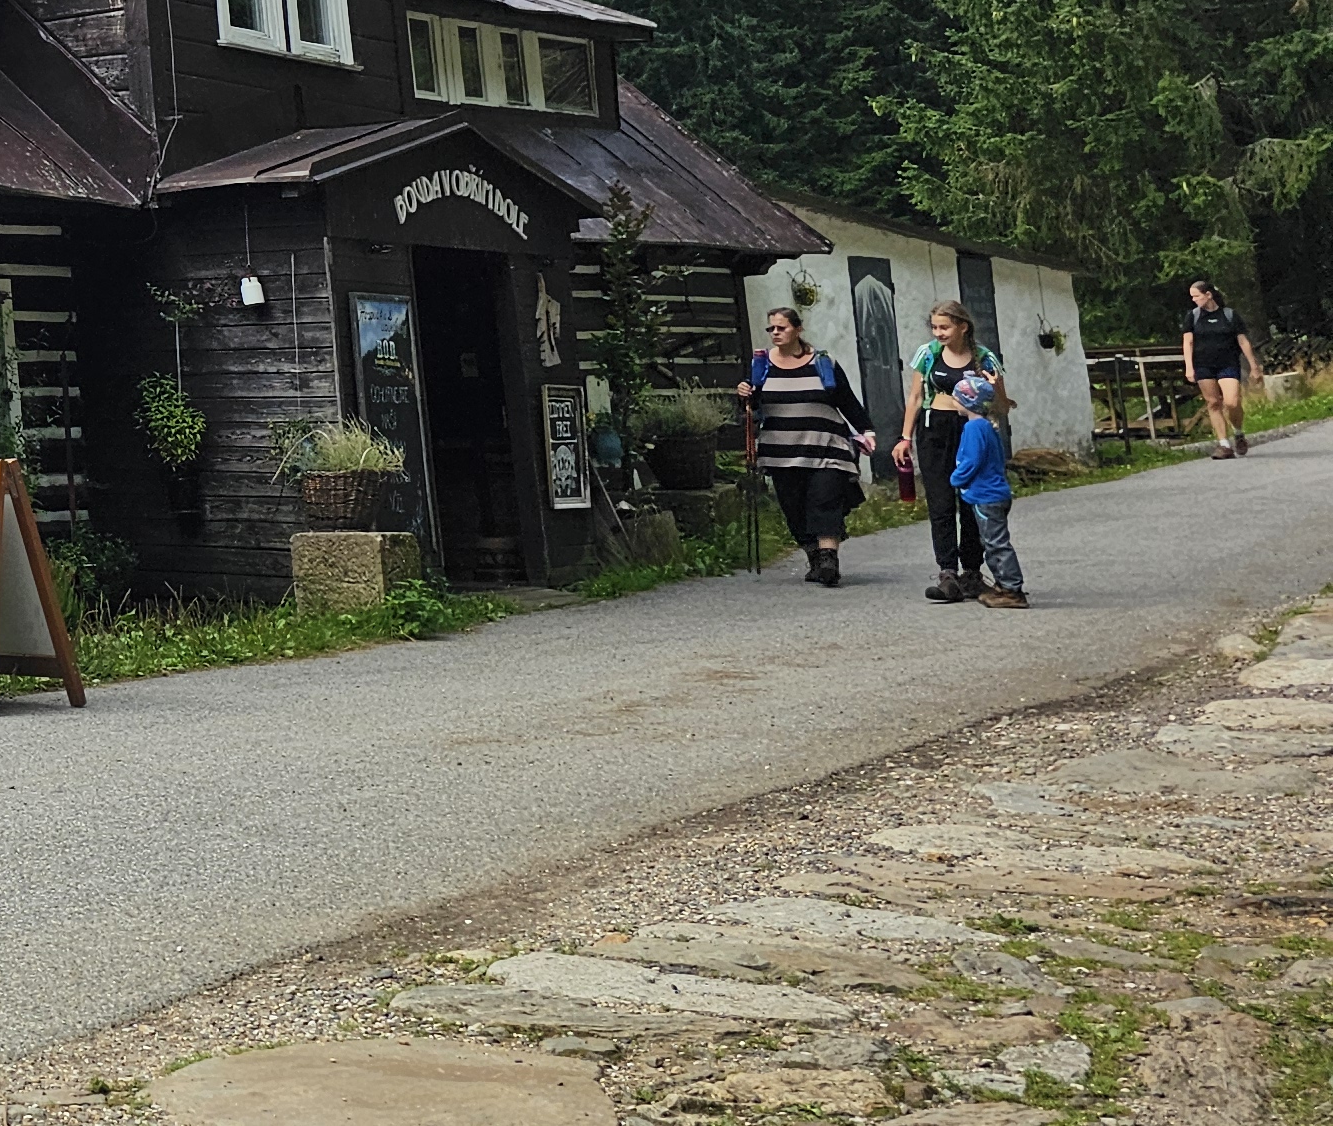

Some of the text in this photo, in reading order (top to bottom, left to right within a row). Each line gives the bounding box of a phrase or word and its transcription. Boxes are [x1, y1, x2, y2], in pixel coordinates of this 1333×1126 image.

[393, 164, 529, 240] BOUDA V OBŘÍM DOLE
